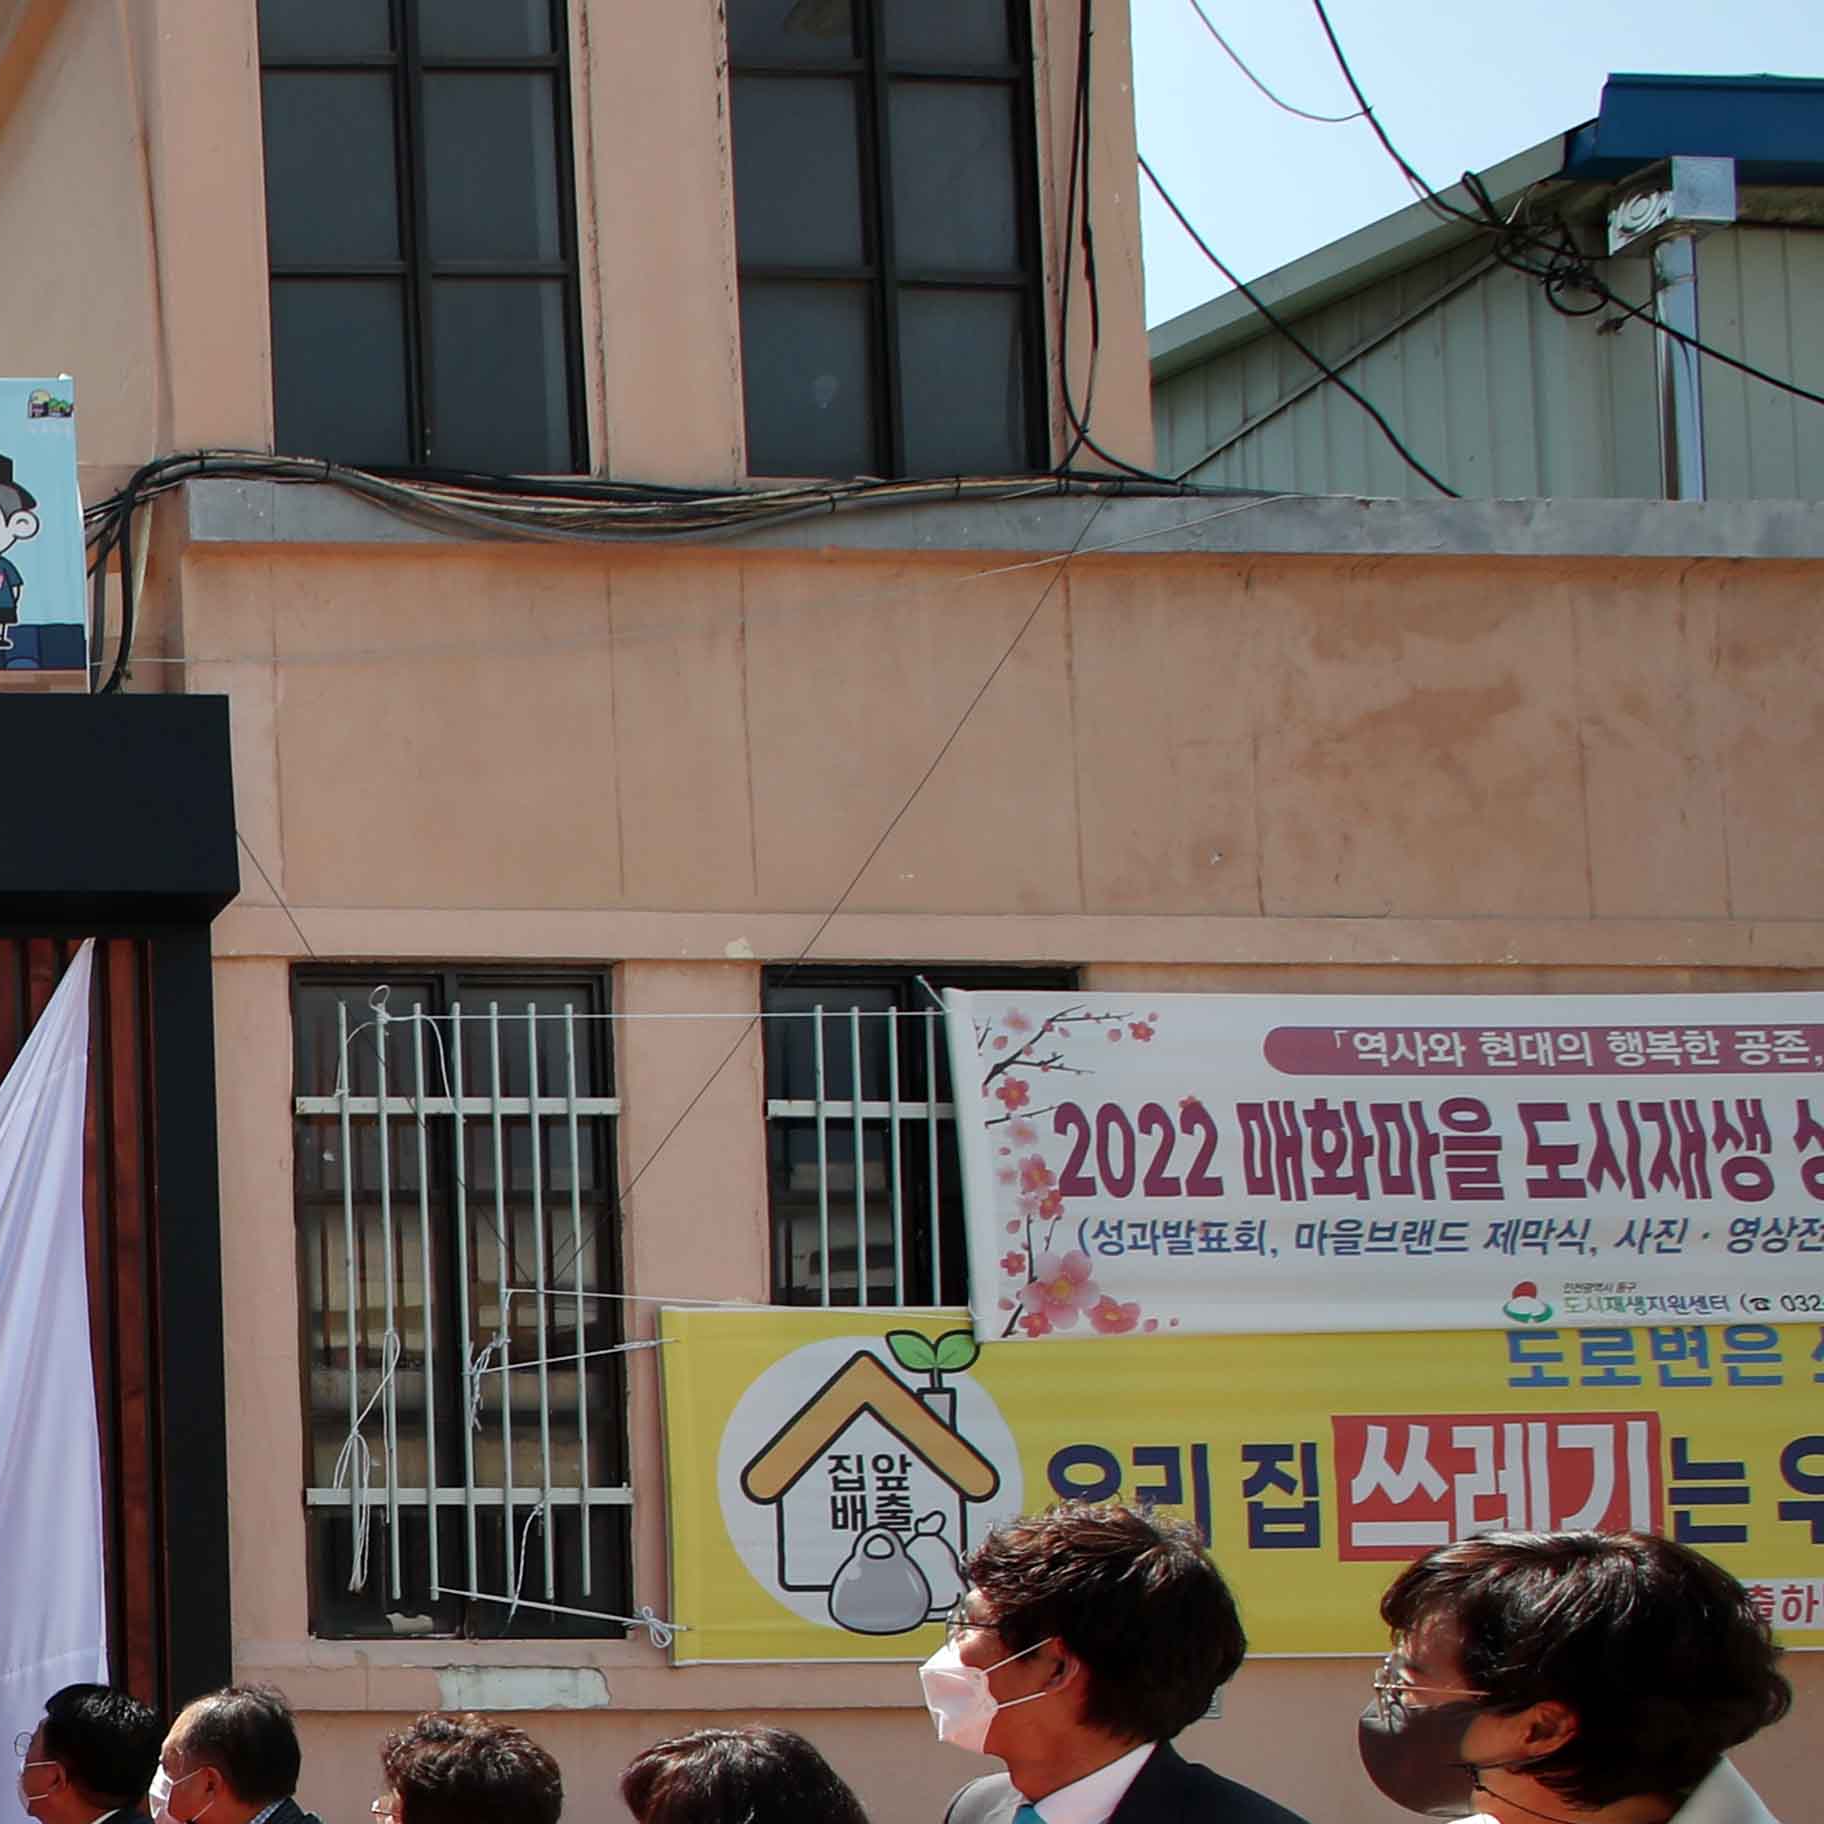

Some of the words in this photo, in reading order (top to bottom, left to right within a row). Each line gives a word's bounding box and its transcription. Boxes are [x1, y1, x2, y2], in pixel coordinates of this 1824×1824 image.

[1479, 1028, 1594, 1068] 현대의
[1606, 1029, 1722, 1067] 행복한
[1053, 1100, 1224, 1200] 2022
[1237, 1098, 1503, 1202] 매화마을
[1518, 1098, 1775, 1203] 도시재생
[1077, 1217, 1279, 1259] (성과발표회,
[1295, 1218, 1471, 1257] 마을브랜드
[1483, 1218, 1599, 1258] 제막식,
[1614, 1217, 1690, 1256] 사진
[1563, 1295, 1730, 1316] 도시재생지원센터
[1509, 1324, 1784, 1388] 도로변은
[1241, 1441, 1321, 1549] 집
